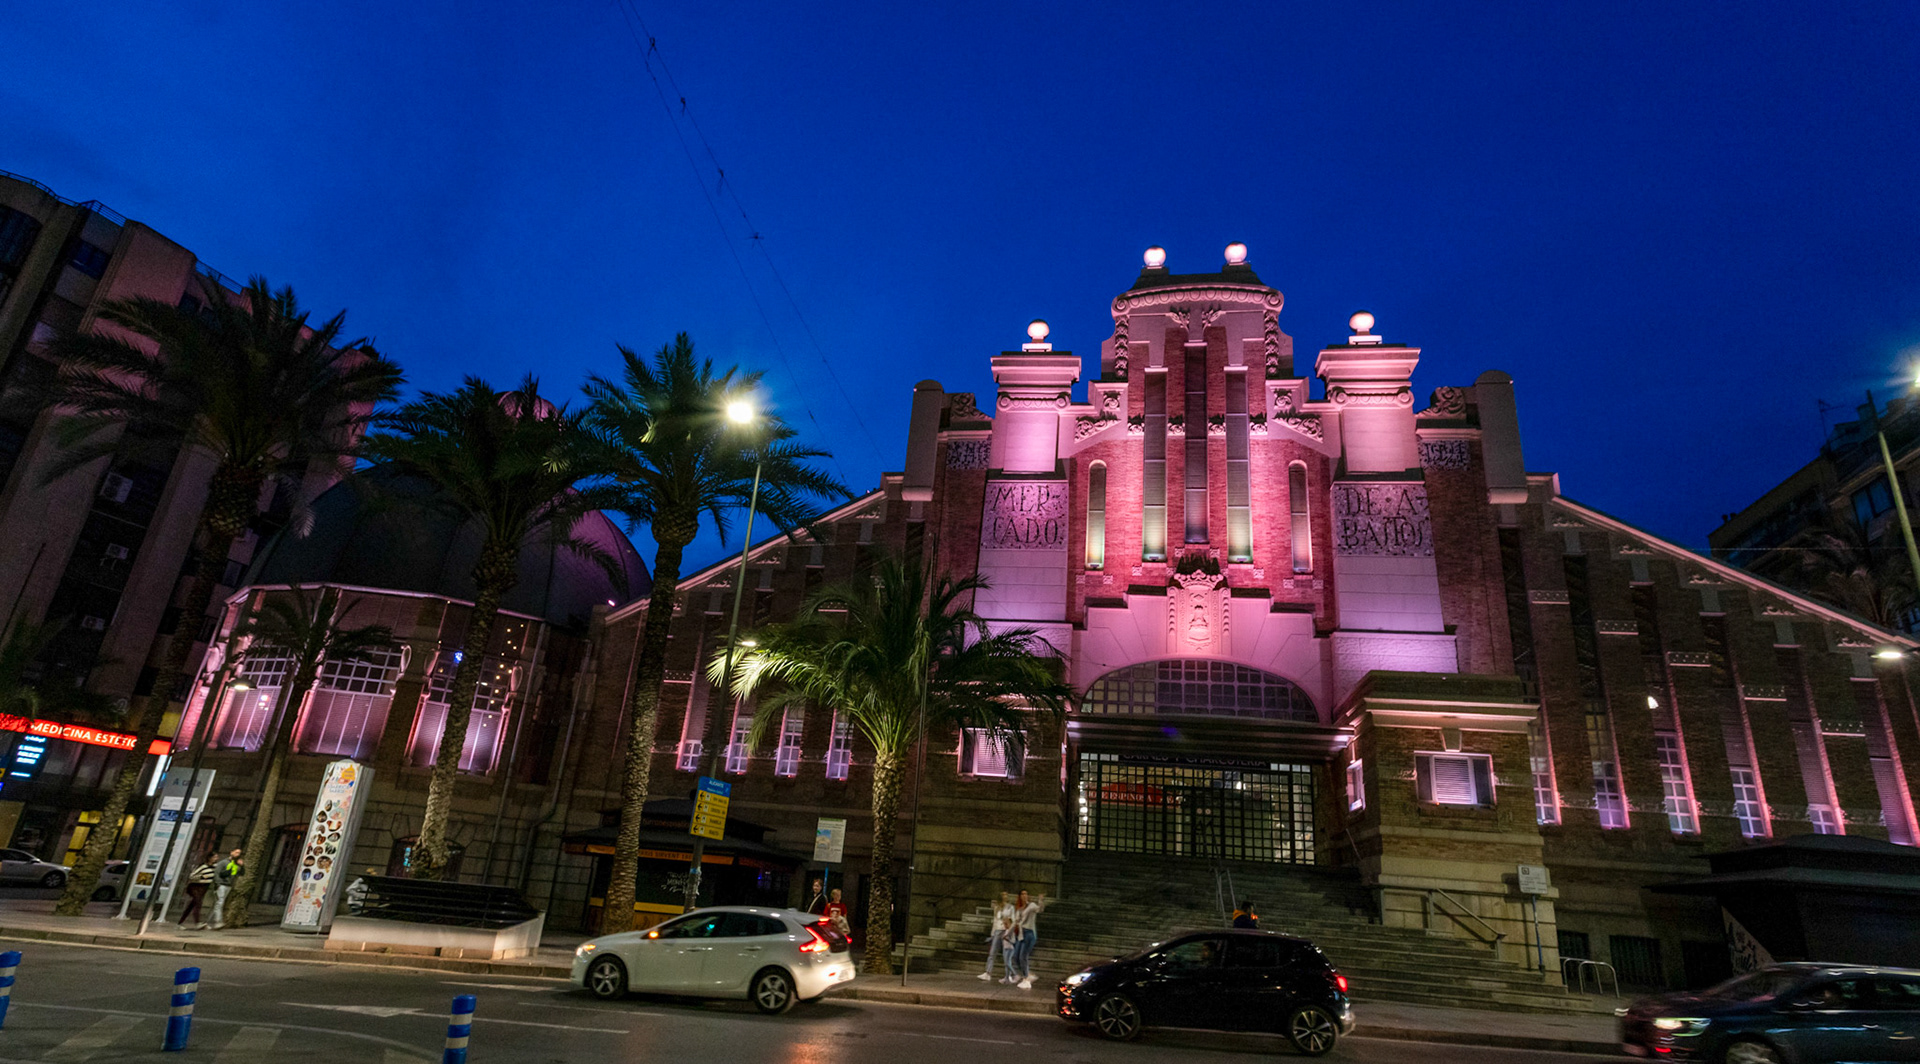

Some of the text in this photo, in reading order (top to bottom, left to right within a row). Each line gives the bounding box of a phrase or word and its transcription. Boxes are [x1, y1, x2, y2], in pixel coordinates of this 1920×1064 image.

[991, 485, 1061, 512] MER-
[1342, 487, 1383, 516] DE
[993, 515, 1059, 545] CADO
[30, 722, 91, 741] MEDICINA
[94, 732, 138, 748] ESTETIC
